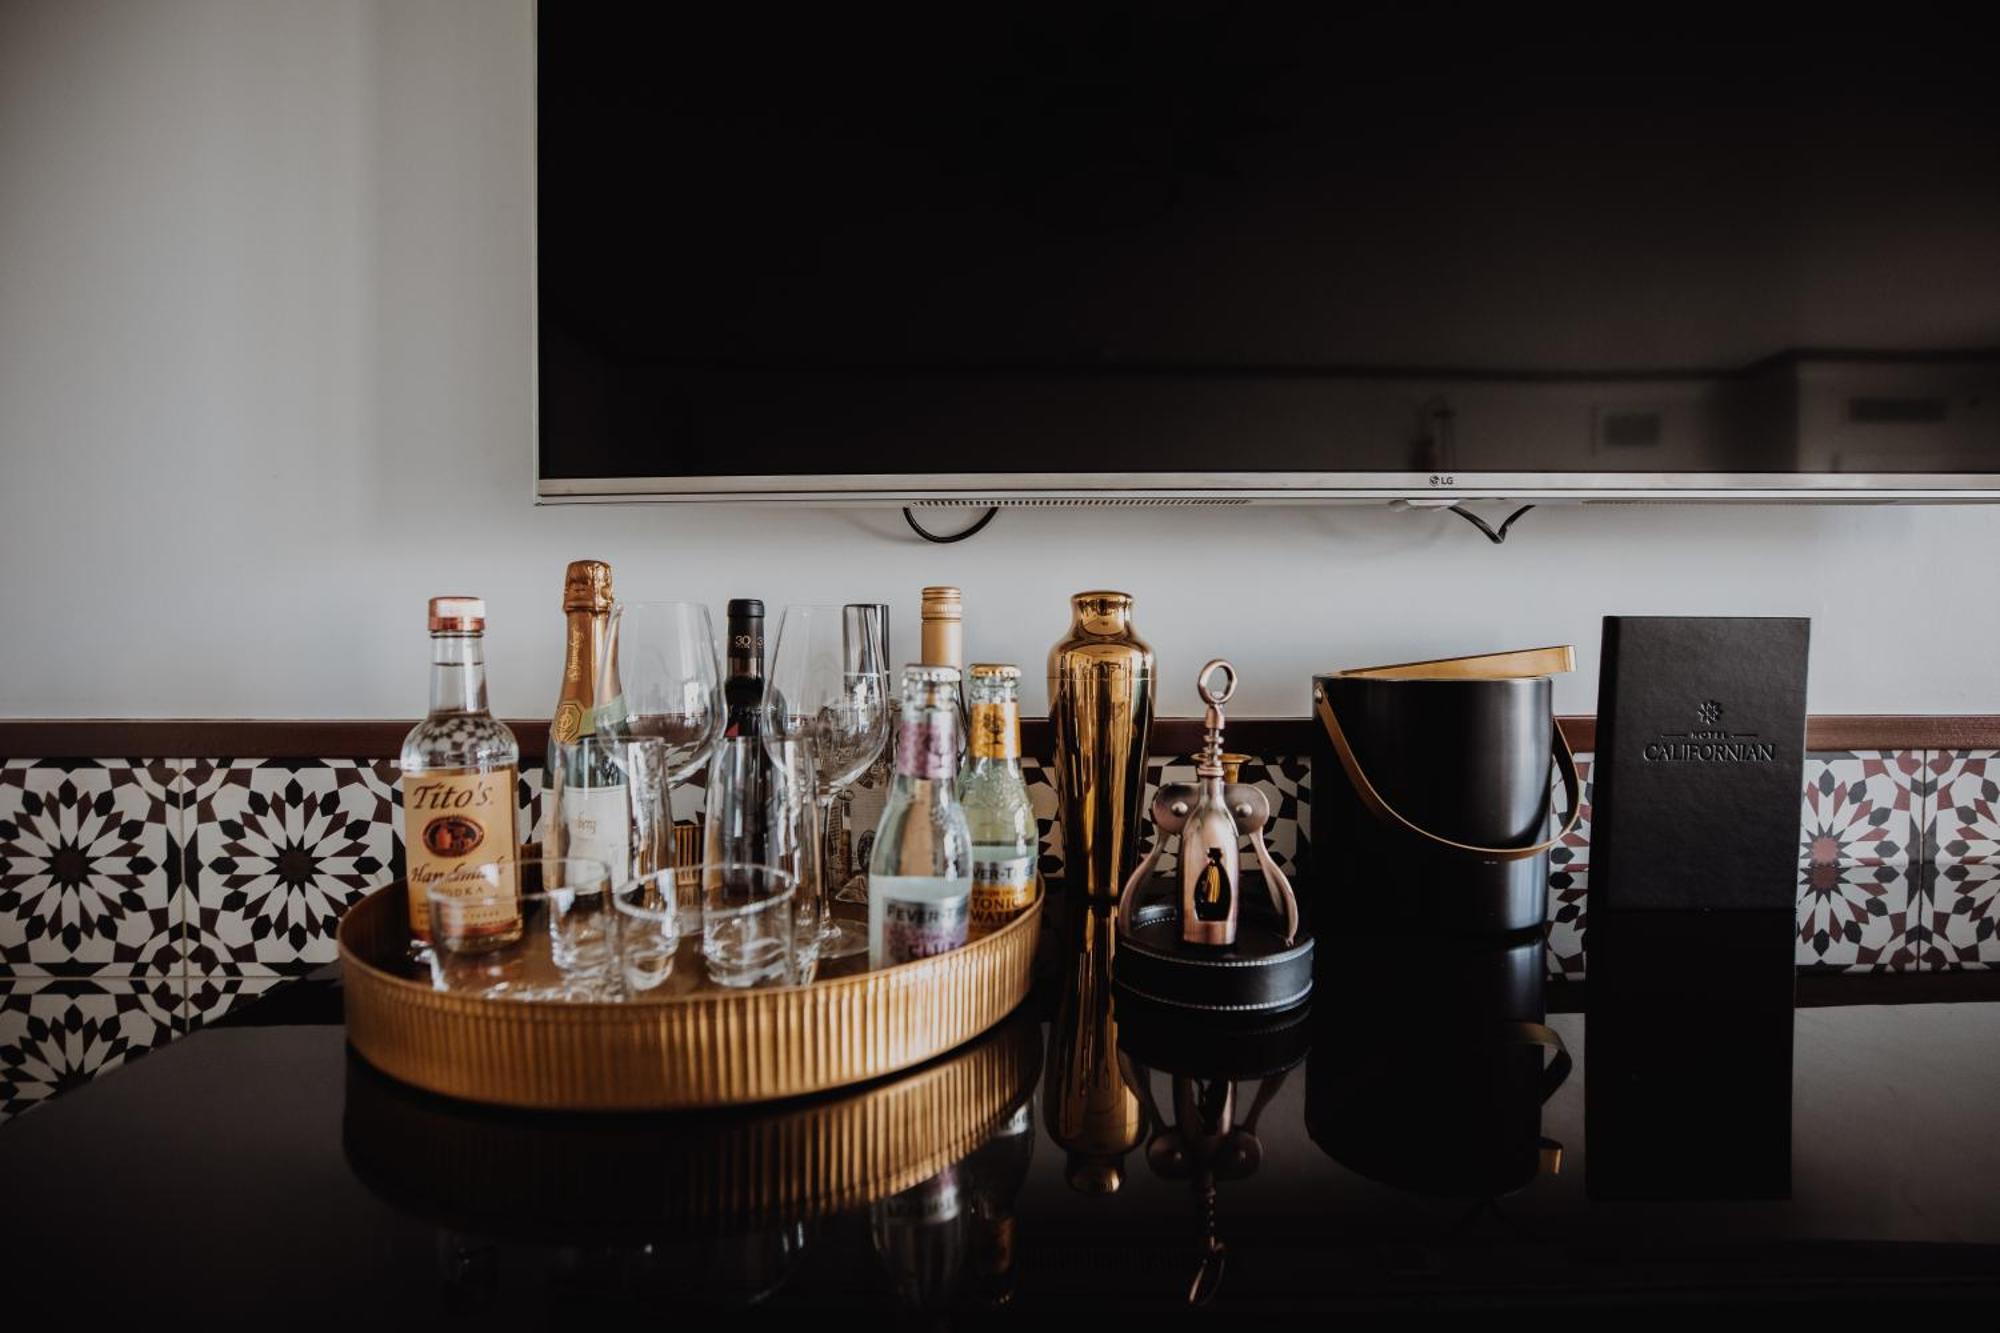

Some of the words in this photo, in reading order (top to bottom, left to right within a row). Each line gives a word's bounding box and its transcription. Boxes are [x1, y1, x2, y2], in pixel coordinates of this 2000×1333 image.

[1440, 476, 1454, 486] LG
[1643, 743, 1776, 762] CALIFORNIAN
[413, 781, 494, 809] Tito's
[410, 856, 505, 883] Handma
[887, 903, 967, 922] FEVER-T
[971, 909, 1014, 922] WATE
